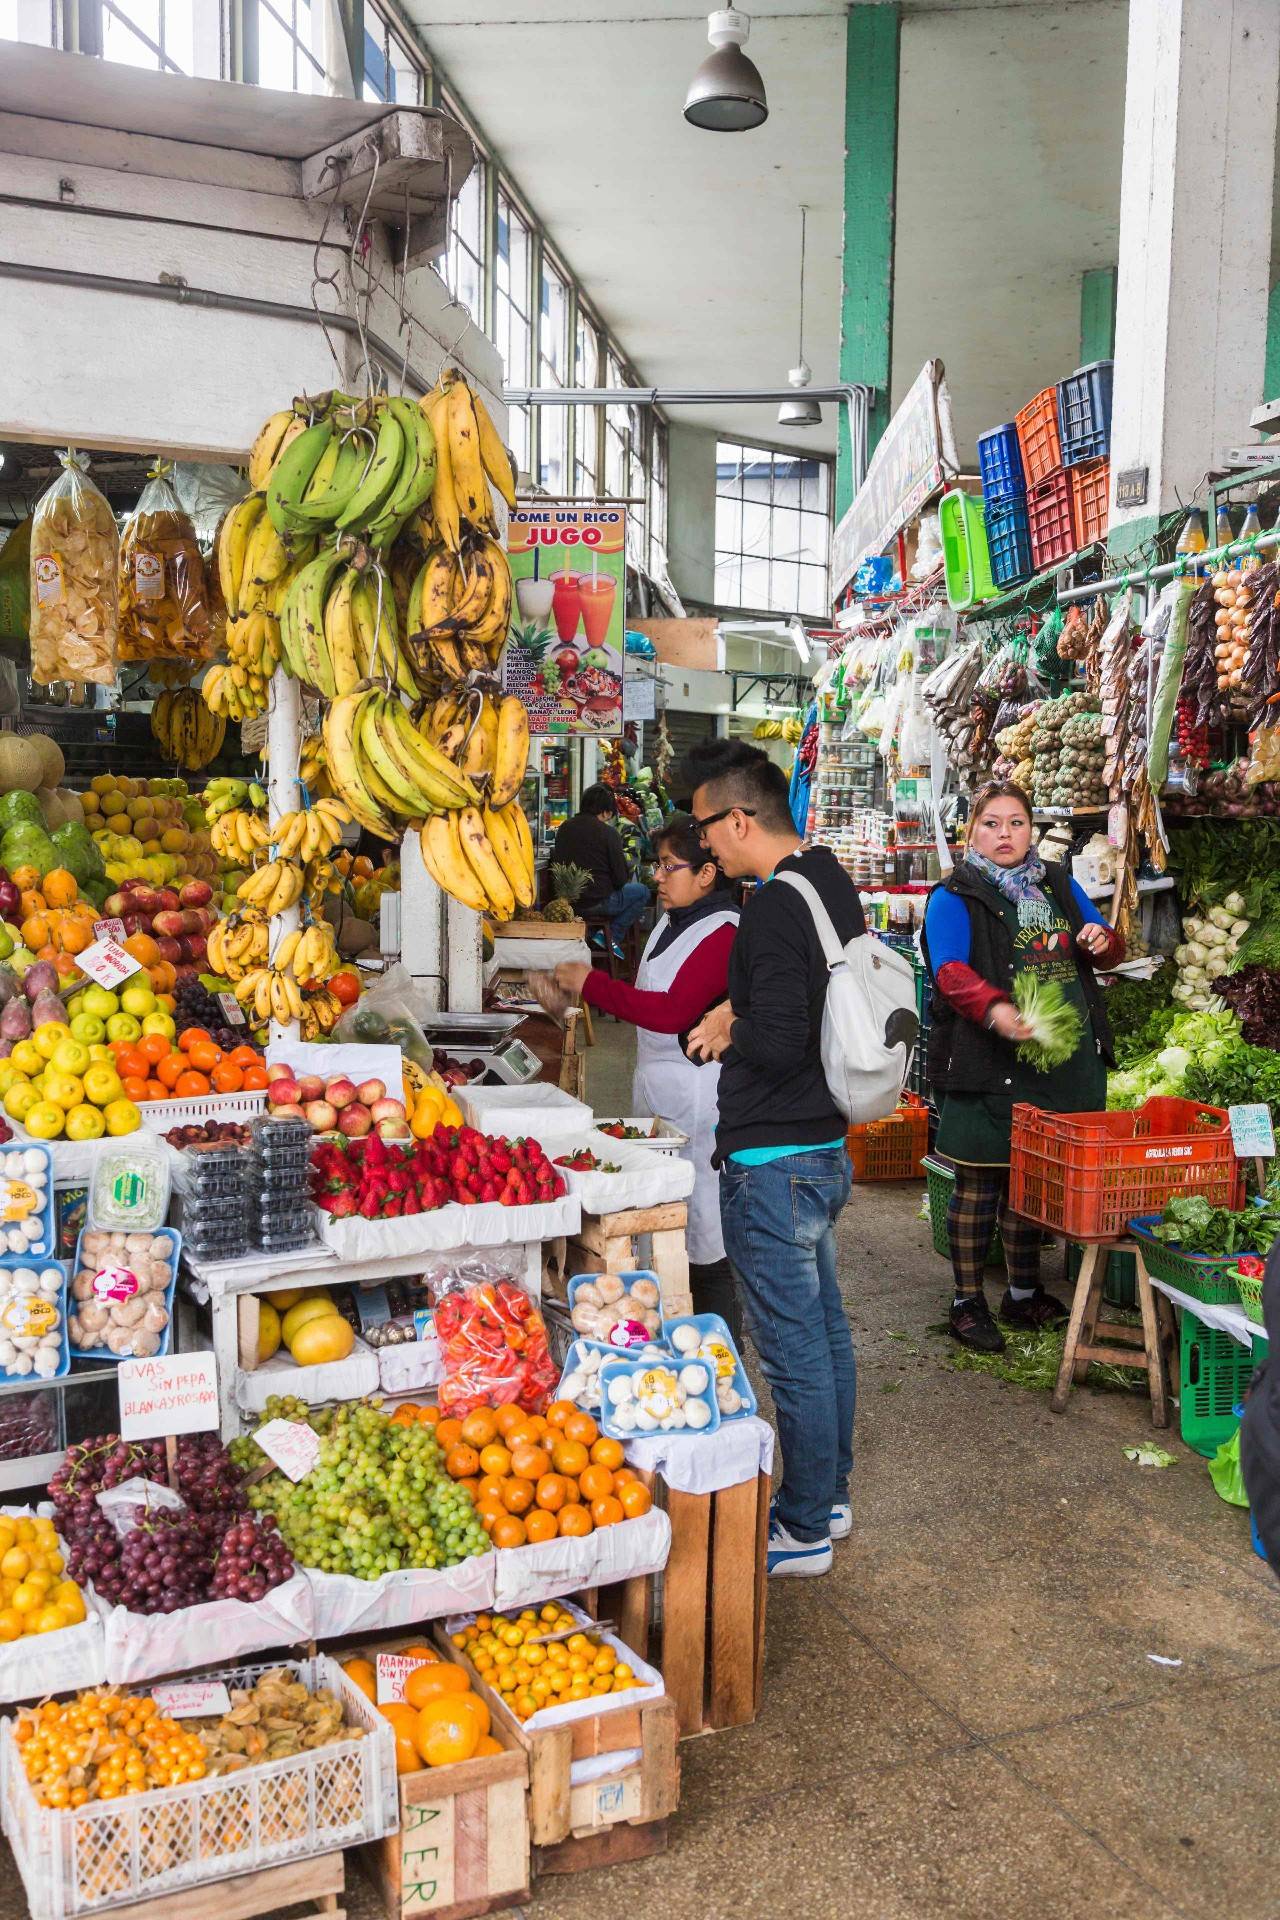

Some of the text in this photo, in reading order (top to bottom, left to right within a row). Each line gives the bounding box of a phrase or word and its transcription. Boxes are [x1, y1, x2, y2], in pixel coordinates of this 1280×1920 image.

[509, 513, 620, 522] TOME UN RICO
[526, 528, 602, 545] JUGO
[121, 1362, 165, 1380] UVAS
[392, 1681, 405, 1700] 5
